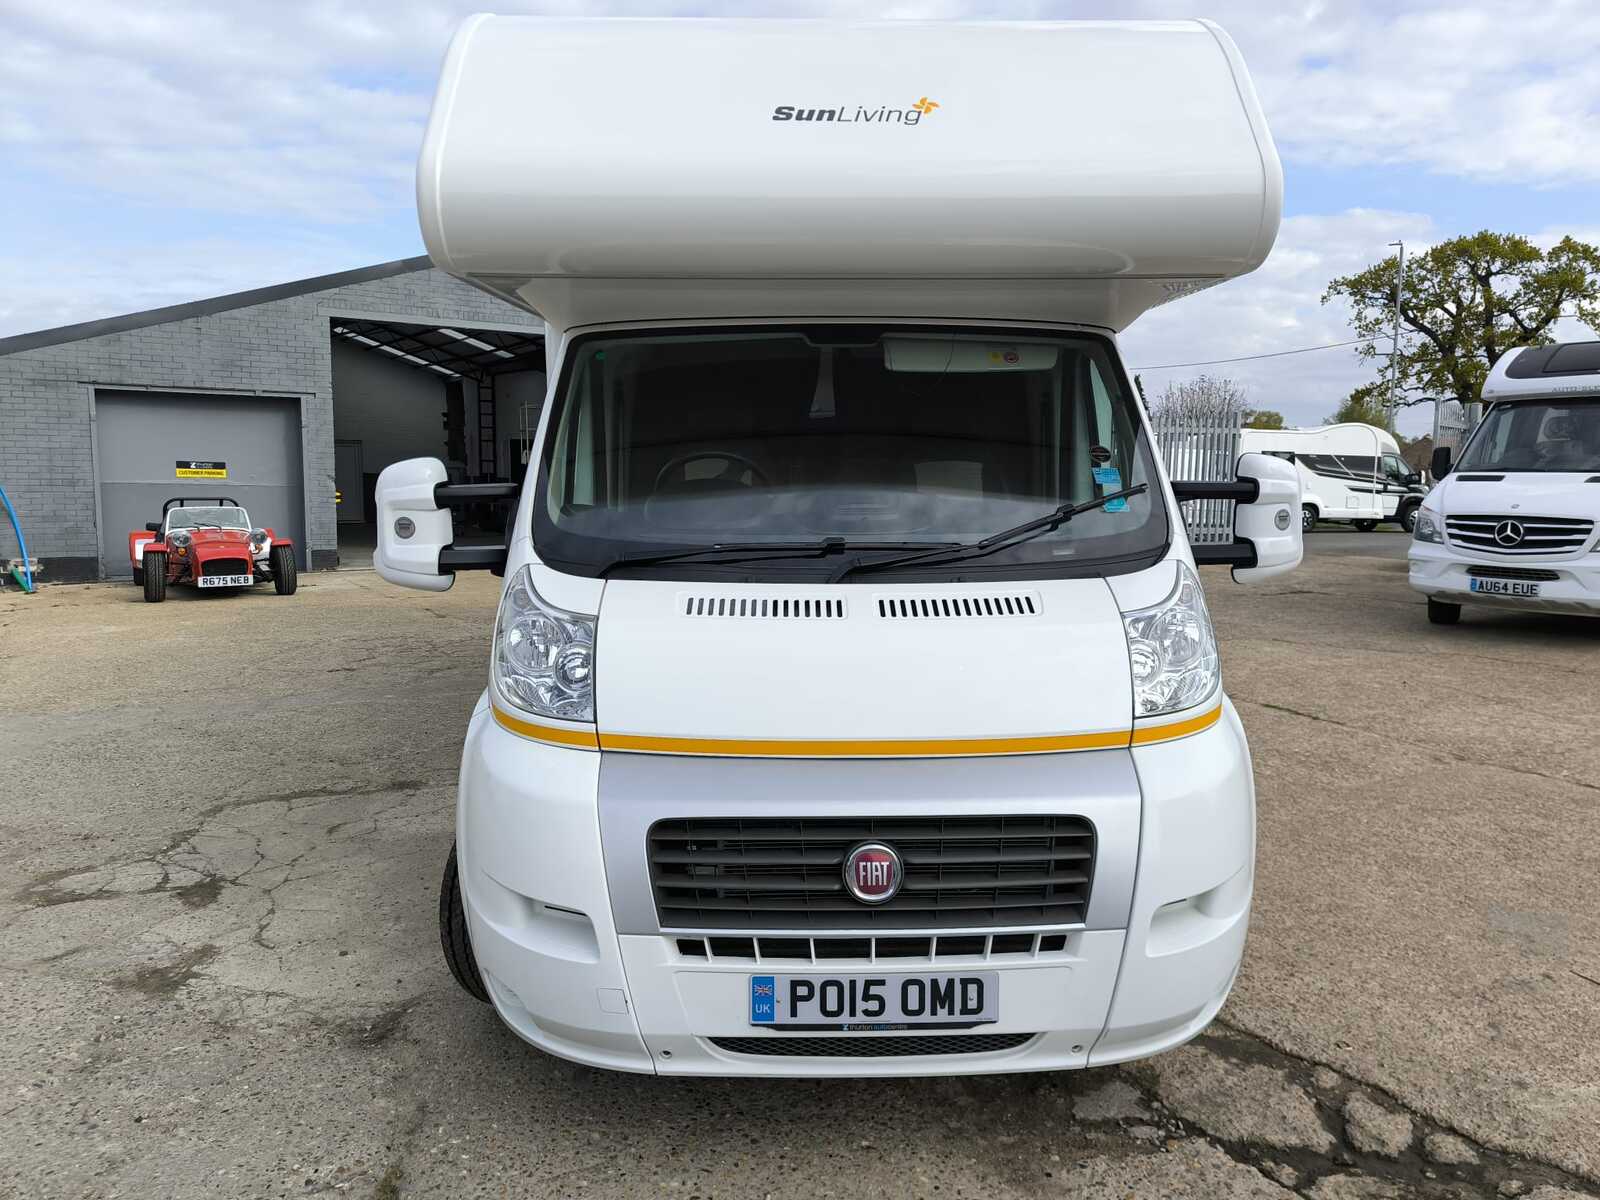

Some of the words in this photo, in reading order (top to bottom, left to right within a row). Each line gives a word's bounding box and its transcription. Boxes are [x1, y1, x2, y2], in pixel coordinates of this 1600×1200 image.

[202, 577, 228, 586] R675
[230, 576, 249, 584] NEB
[1478, 580, 1509, 592] AU64
[1512, 583, 1539, 595] EUE
[859, 861, 890, 886] FIAT
[789, 979, 886, 1018] PO15
[901, 977, 985, 1016] OMD
[755, 1003, 771, 1014] UK
